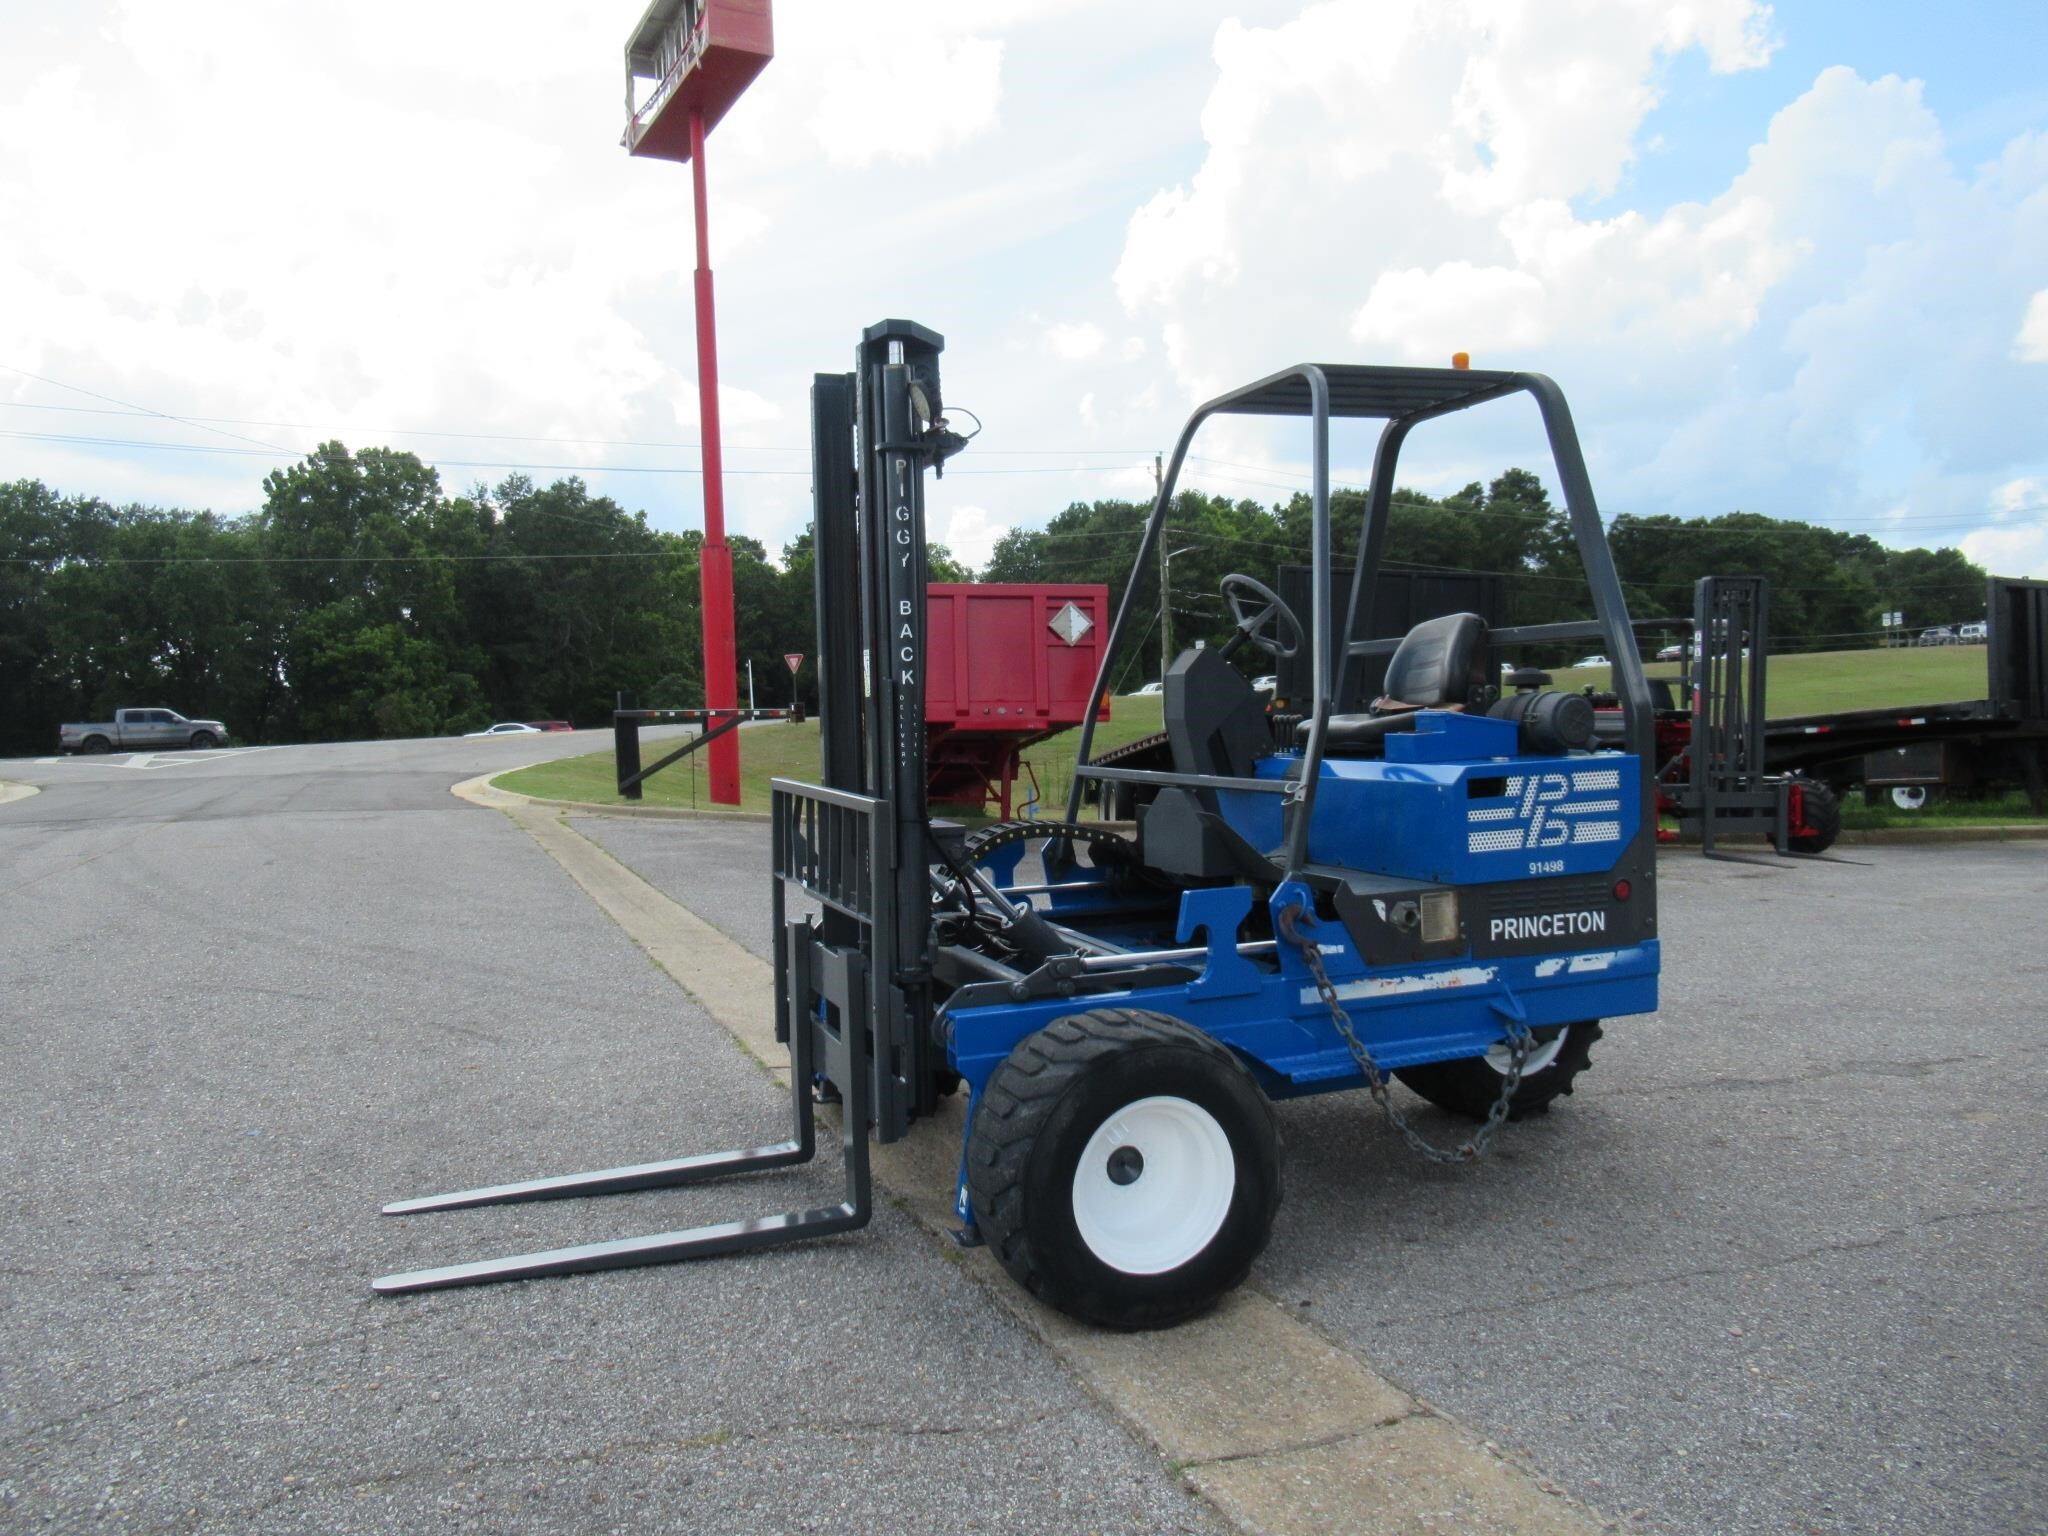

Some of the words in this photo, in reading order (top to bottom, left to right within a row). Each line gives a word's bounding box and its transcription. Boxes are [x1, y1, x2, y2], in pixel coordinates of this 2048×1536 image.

[896, 459, 911, 568] PIGGY
[900, 600, 914, 685] BACK
[1528, 859, 1564, 874] 91498
[1490, 910, 1605, 941] PRINCETON
